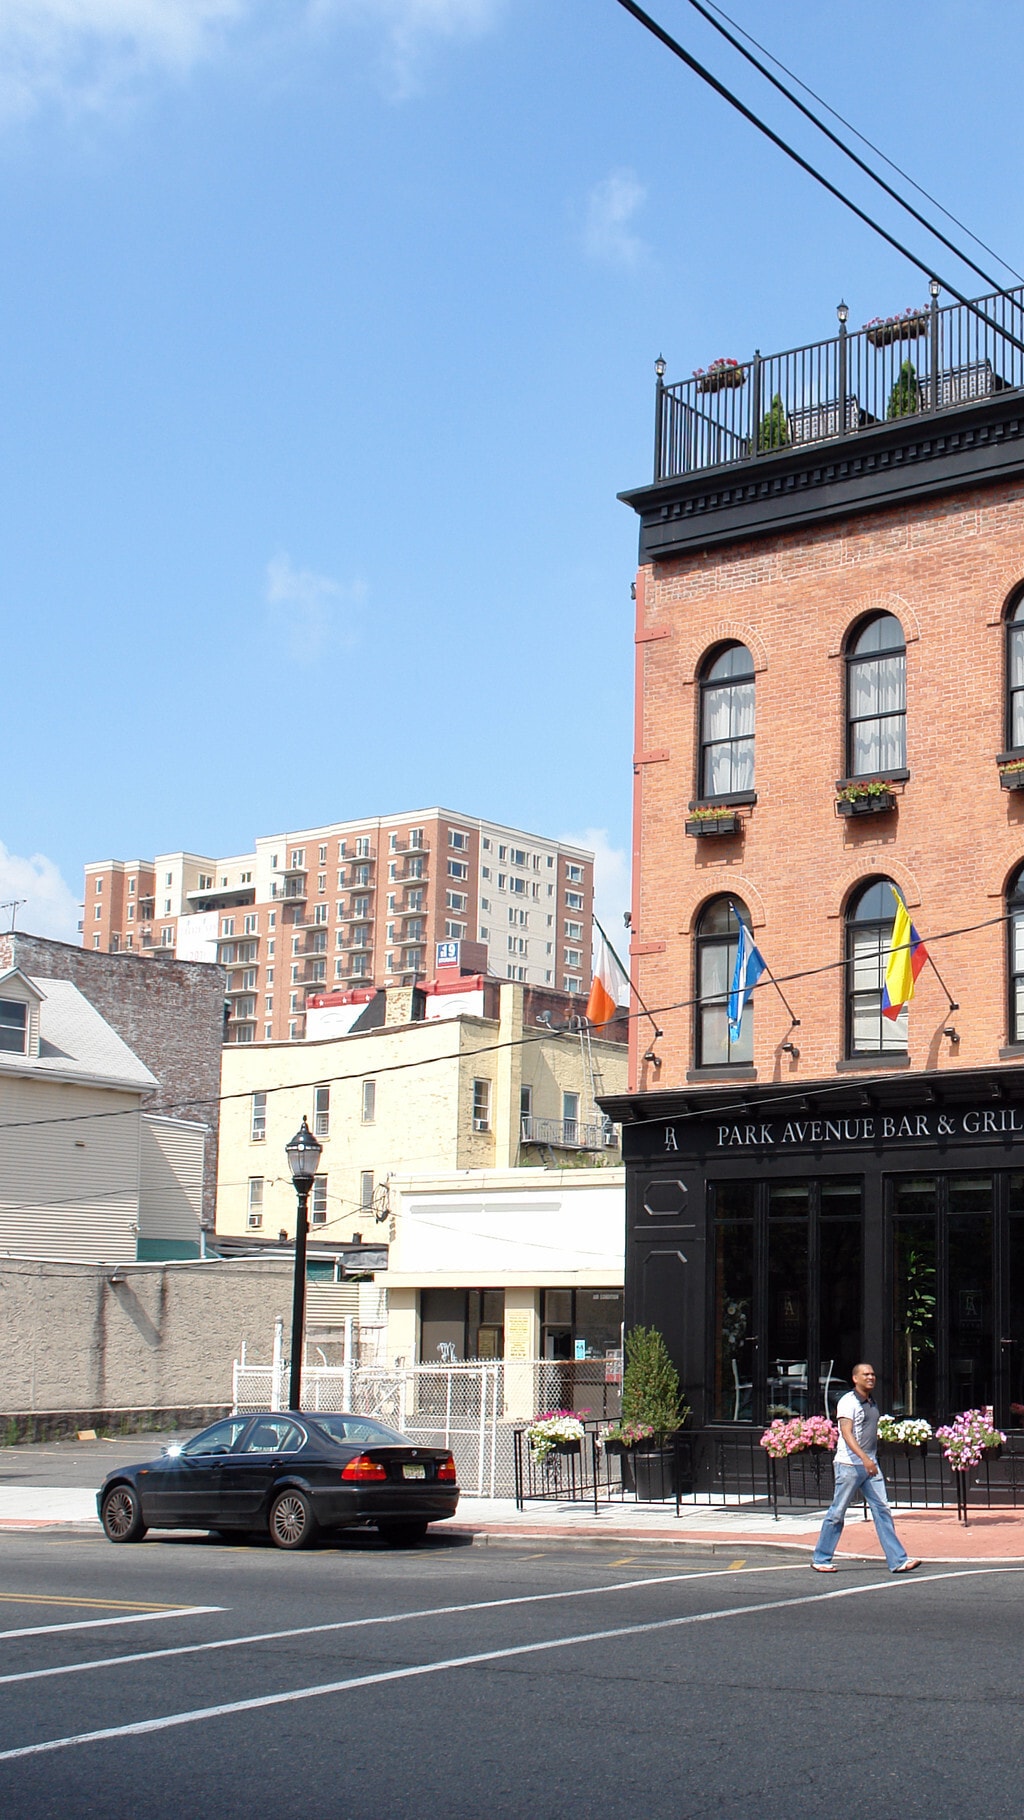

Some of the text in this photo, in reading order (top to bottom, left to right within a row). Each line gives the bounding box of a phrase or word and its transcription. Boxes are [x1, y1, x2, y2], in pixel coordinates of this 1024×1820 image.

[716, 1123, 775, 1147] PARK
[780, 1117, 876, 1143] AVENUE
[881, 1114, 931, 1138] BAR
[937, 1114, 956, 1135] &
